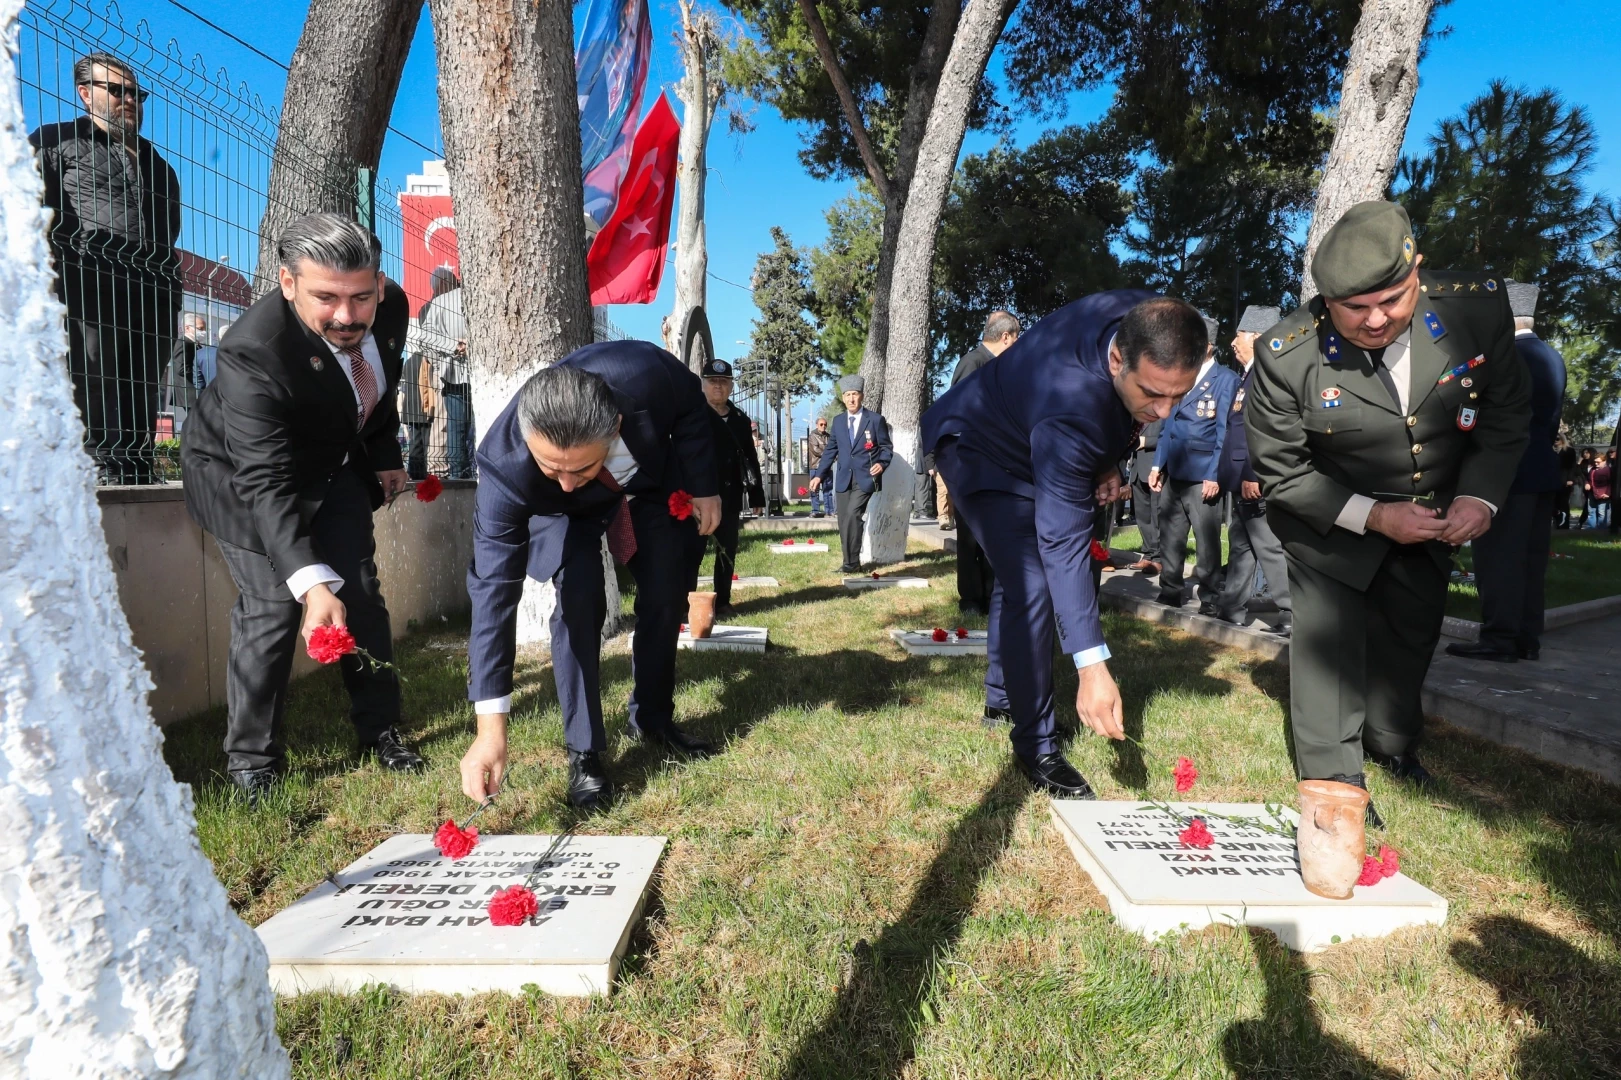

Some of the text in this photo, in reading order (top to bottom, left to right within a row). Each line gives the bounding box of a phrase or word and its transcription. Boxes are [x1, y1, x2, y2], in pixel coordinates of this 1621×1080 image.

[1159, 853, 1300, 863] UNUS KIZI
[386, 860, 443, 868] 1966
[452, 860, 528, 868] MAYIS
[373, 870, 433, 878] 1960
[440, 870, 516, 879] OCAK
[1170, 866, 1242, 877] BAKİ
[333, 883, 617, 897] ERKN DERELİ
[356, 899, 451, 912] OĞLU
[340, 915, 552, 929] AAH BAKİ
